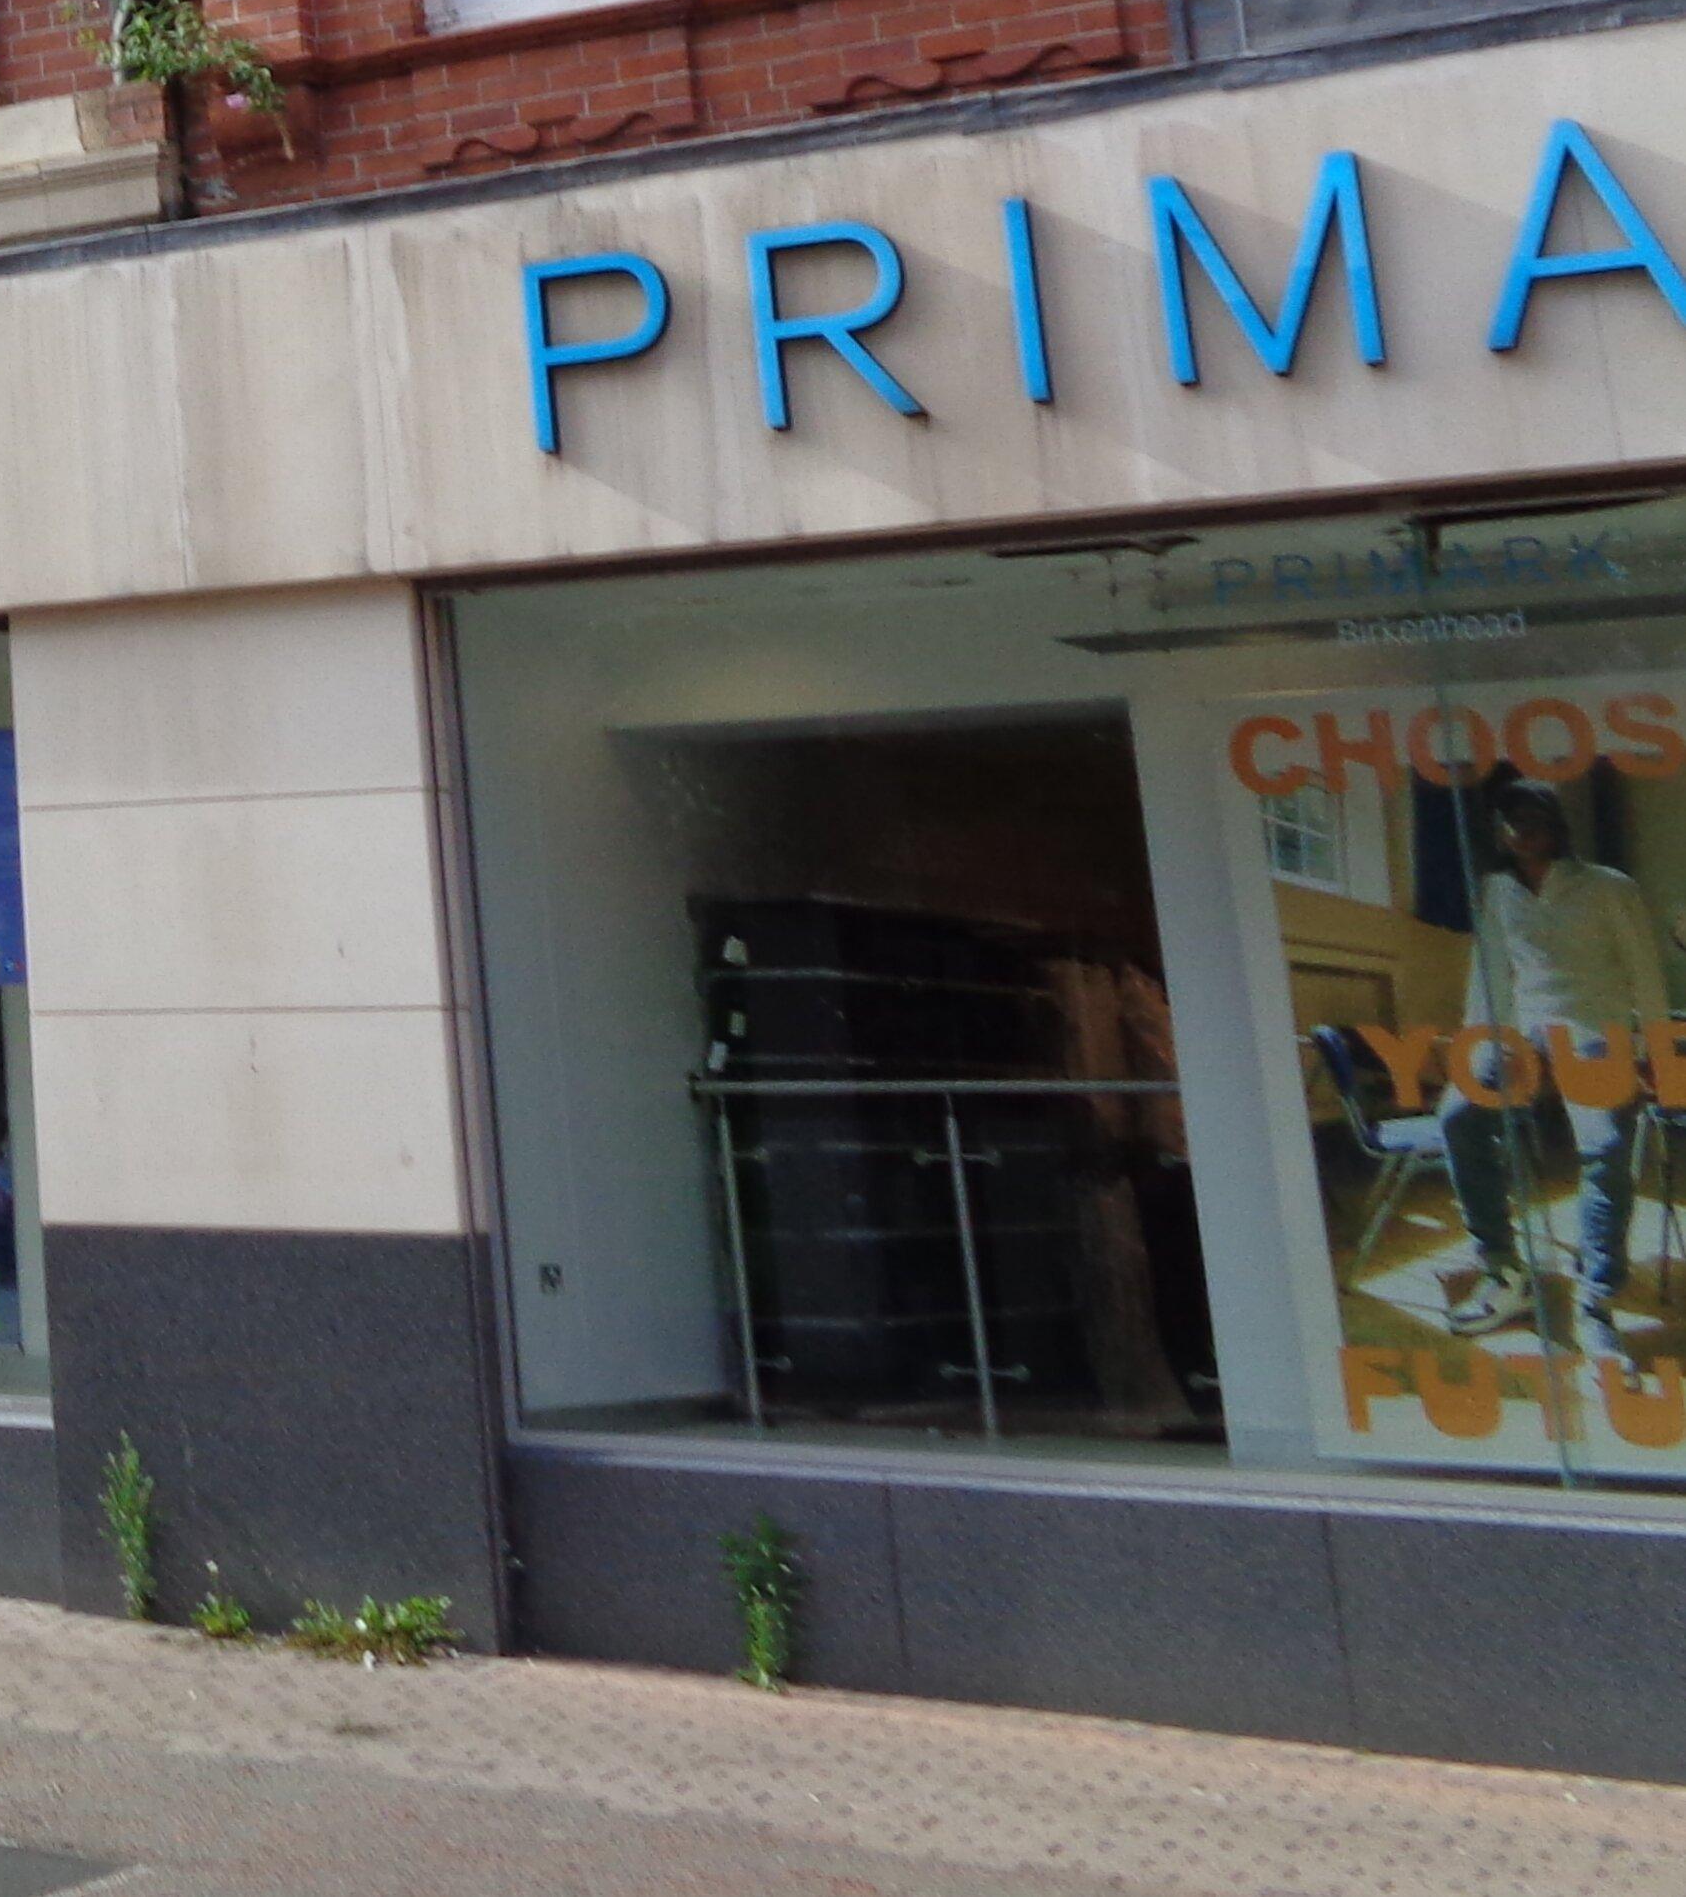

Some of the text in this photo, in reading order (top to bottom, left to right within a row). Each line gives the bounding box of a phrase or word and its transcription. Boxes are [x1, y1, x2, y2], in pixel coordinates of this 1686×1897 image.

[521, 119, 1686, 455] PRIMA
[1211, 531, 1628, 605] PRIMARK
[1337, 609, 1528, 648] Birkenhead
[1230, 693, 1686, 796] CHOOS
[1338, 1345, 1686, 1450] FUTU
